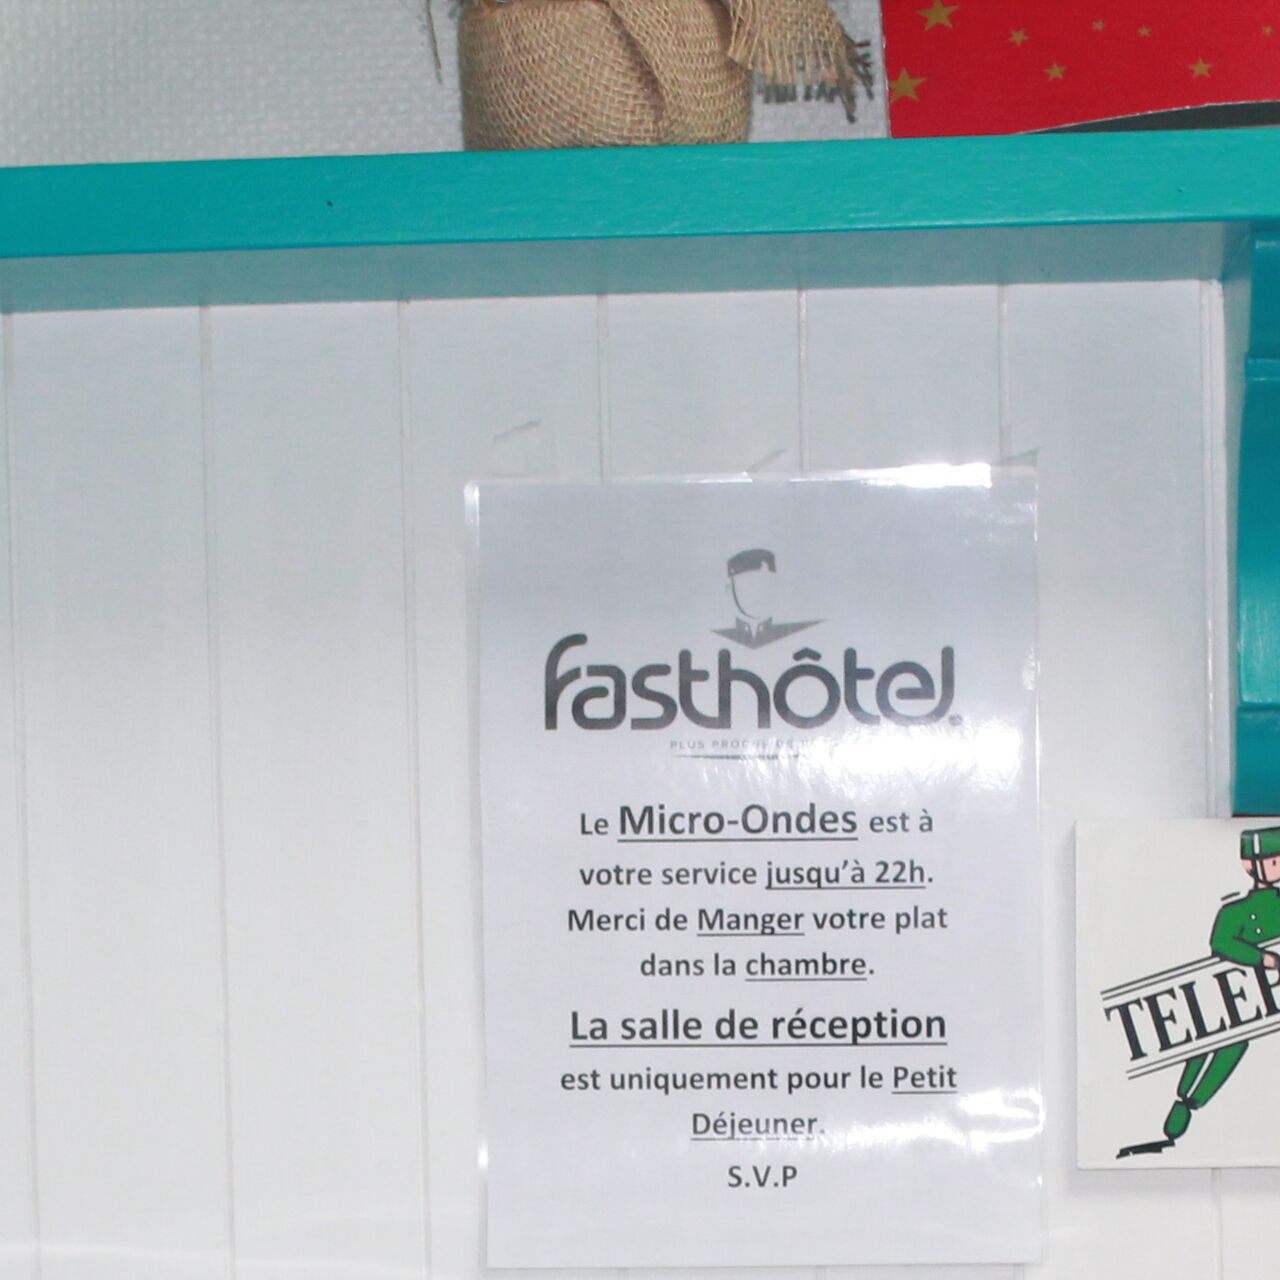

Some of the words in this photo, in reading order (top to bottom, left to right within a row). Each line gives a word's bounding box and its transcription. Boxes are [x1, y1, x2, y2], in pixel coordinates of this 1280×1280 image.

[668, 739, 705, 750] PLUS
[580, 812, 609, 836] Le
[618, 802, 858, 842] Micro-Ondes
[869, 812, 909, 833] est
[919, 808, 933, 832] à
[579, 866, 653, 886] votre
[661, 864, 757, 885] service
[875, 859, 934, 889] 22h.
[567, 909, 646, 931] Merci
[655, 908, 688, 931] de
[697, 908, 805, 936] Manger
[812, 909, 886, 929] votre
[895, 906, 948, 934] plat
[640, 954, 704, 976] dans
[714, 953, 736, 975] la
[745, 951, 875, 981] chambre.
[570, 1011, 608, 1047] La
[620, 1009, 702, 1046] salle
[715, 1009, 759, 1046] de
[771, 1008, 948, 1045] réception
[560, 1070, 600, 1090] est
[610, 1066, 778, 1095] uniquement
[788, 1070, 851, 1094] pour
[861, 1065, 883, 1089] le
[892, 1065, 958, 1094] Petit
[690, 1112, 826, 1140] Déjeuner.
[727, 1166, 798, 1188] S.V.P
